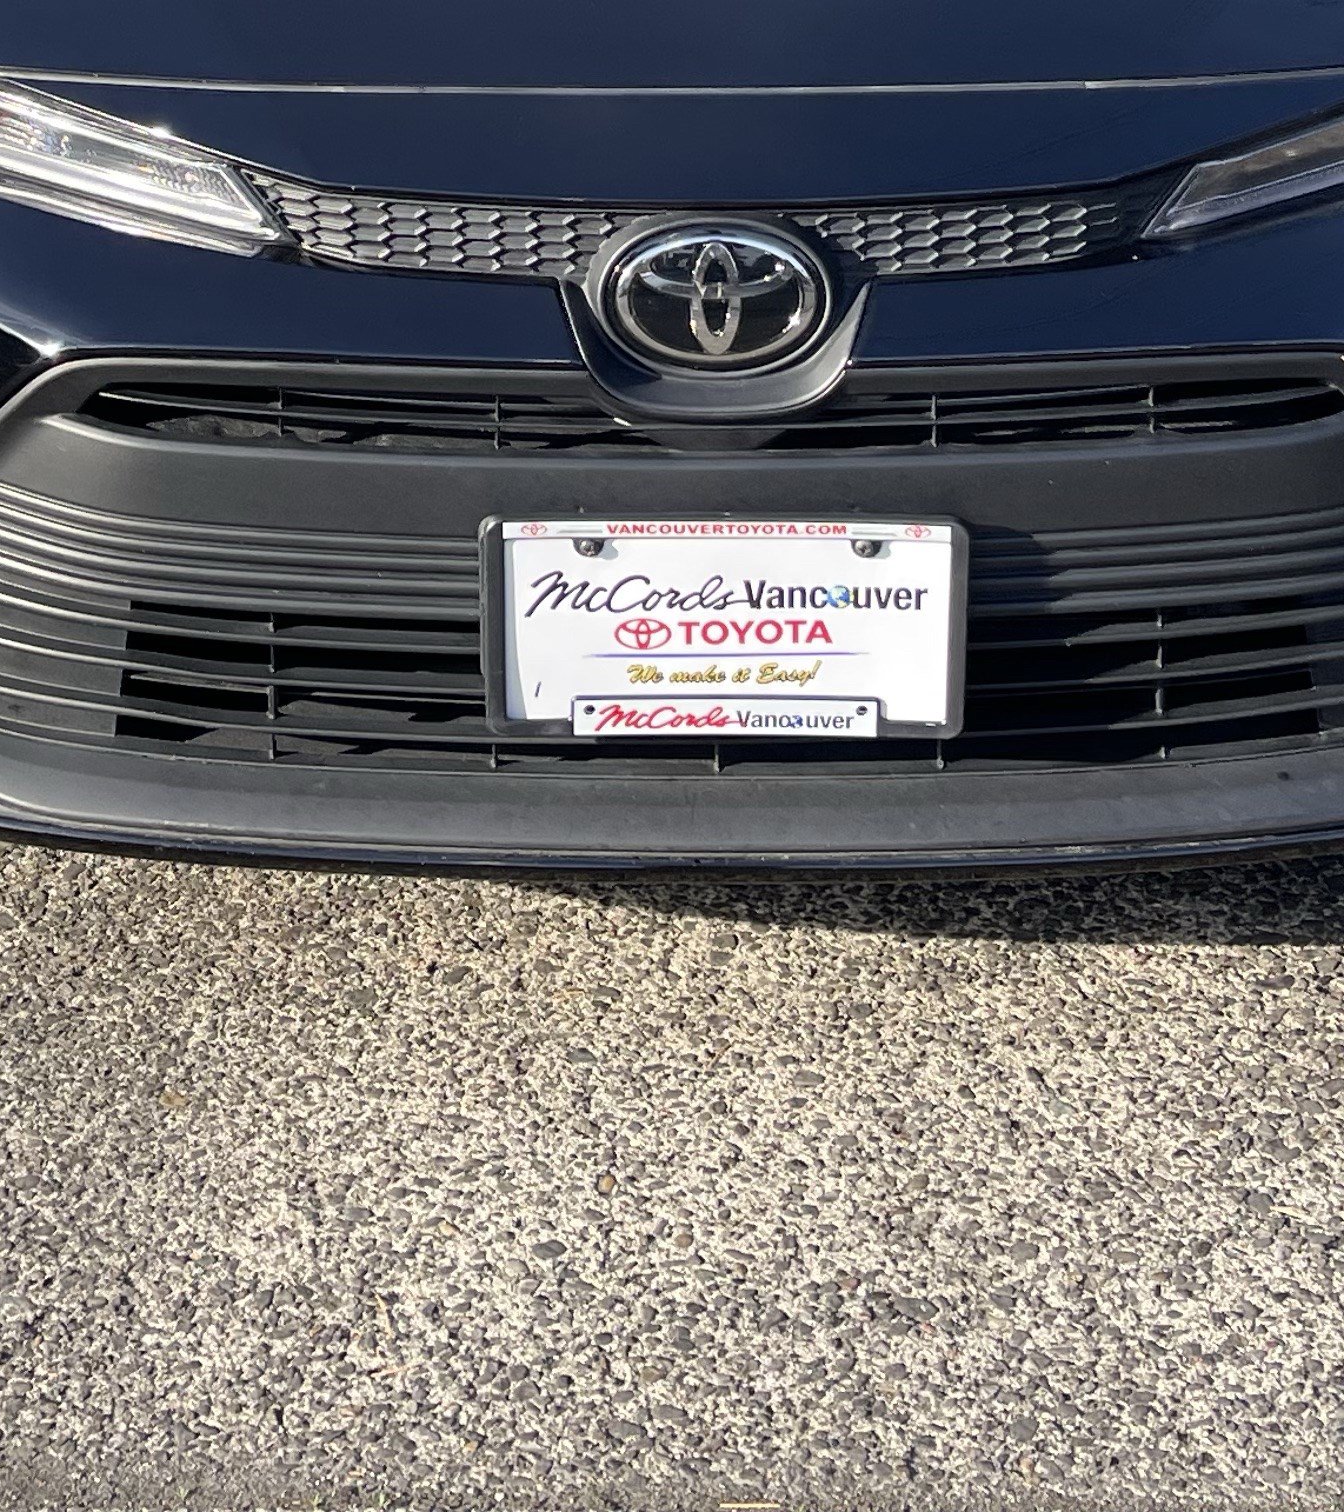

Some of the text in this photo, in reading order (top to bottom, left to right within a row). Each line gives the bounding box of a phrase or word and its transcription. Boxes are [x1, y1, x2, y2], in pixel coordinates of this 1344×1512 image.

[606, 523, 847, 535] VANCOUVERTOYOTA.COM
[677, 619, 833, 645] TOYOTA
[626, 659, 823, 687] We make it Easy!
